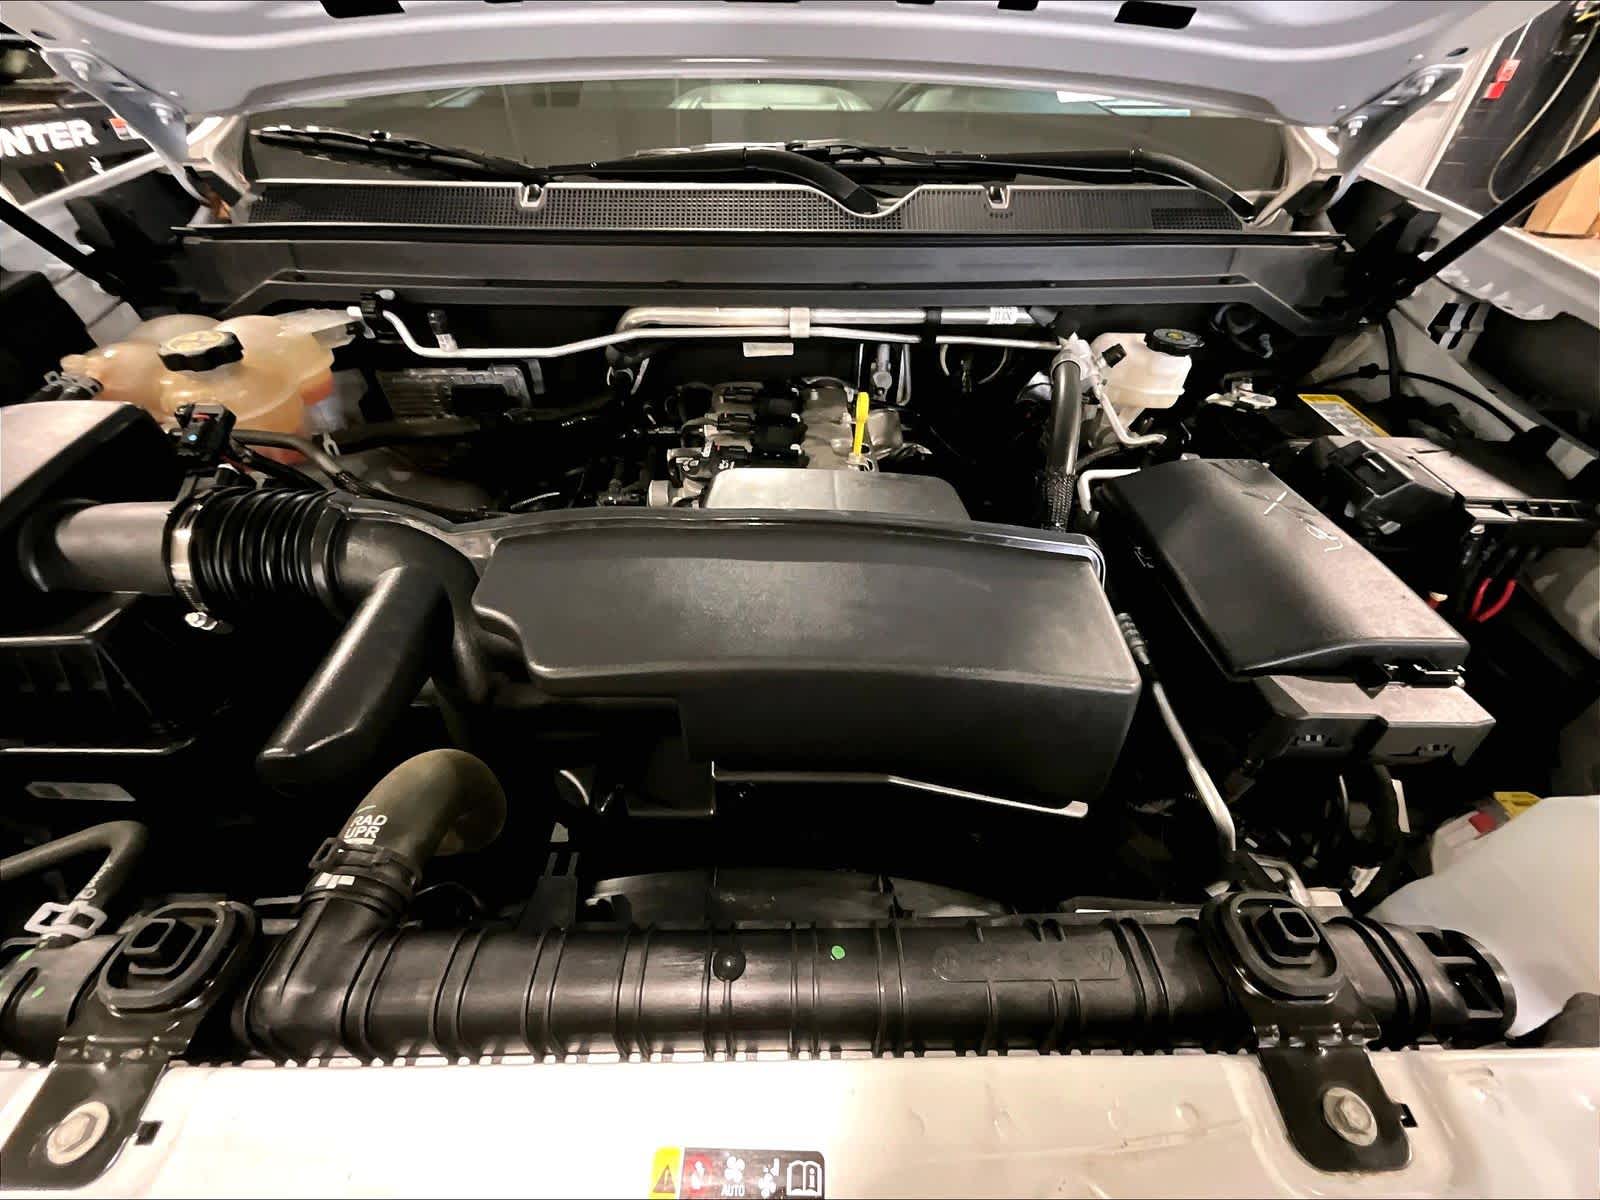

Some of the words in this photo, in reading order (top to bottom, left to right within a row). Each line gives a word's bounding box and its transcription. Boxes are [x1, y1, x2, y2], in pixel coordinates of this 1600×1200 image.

[0, 119, 99, 157] NTER
[350, 814, 388, 827] RAD
[343, 825, 380, 839] UPR
[720, 1184, 745, 1197] AUTO
